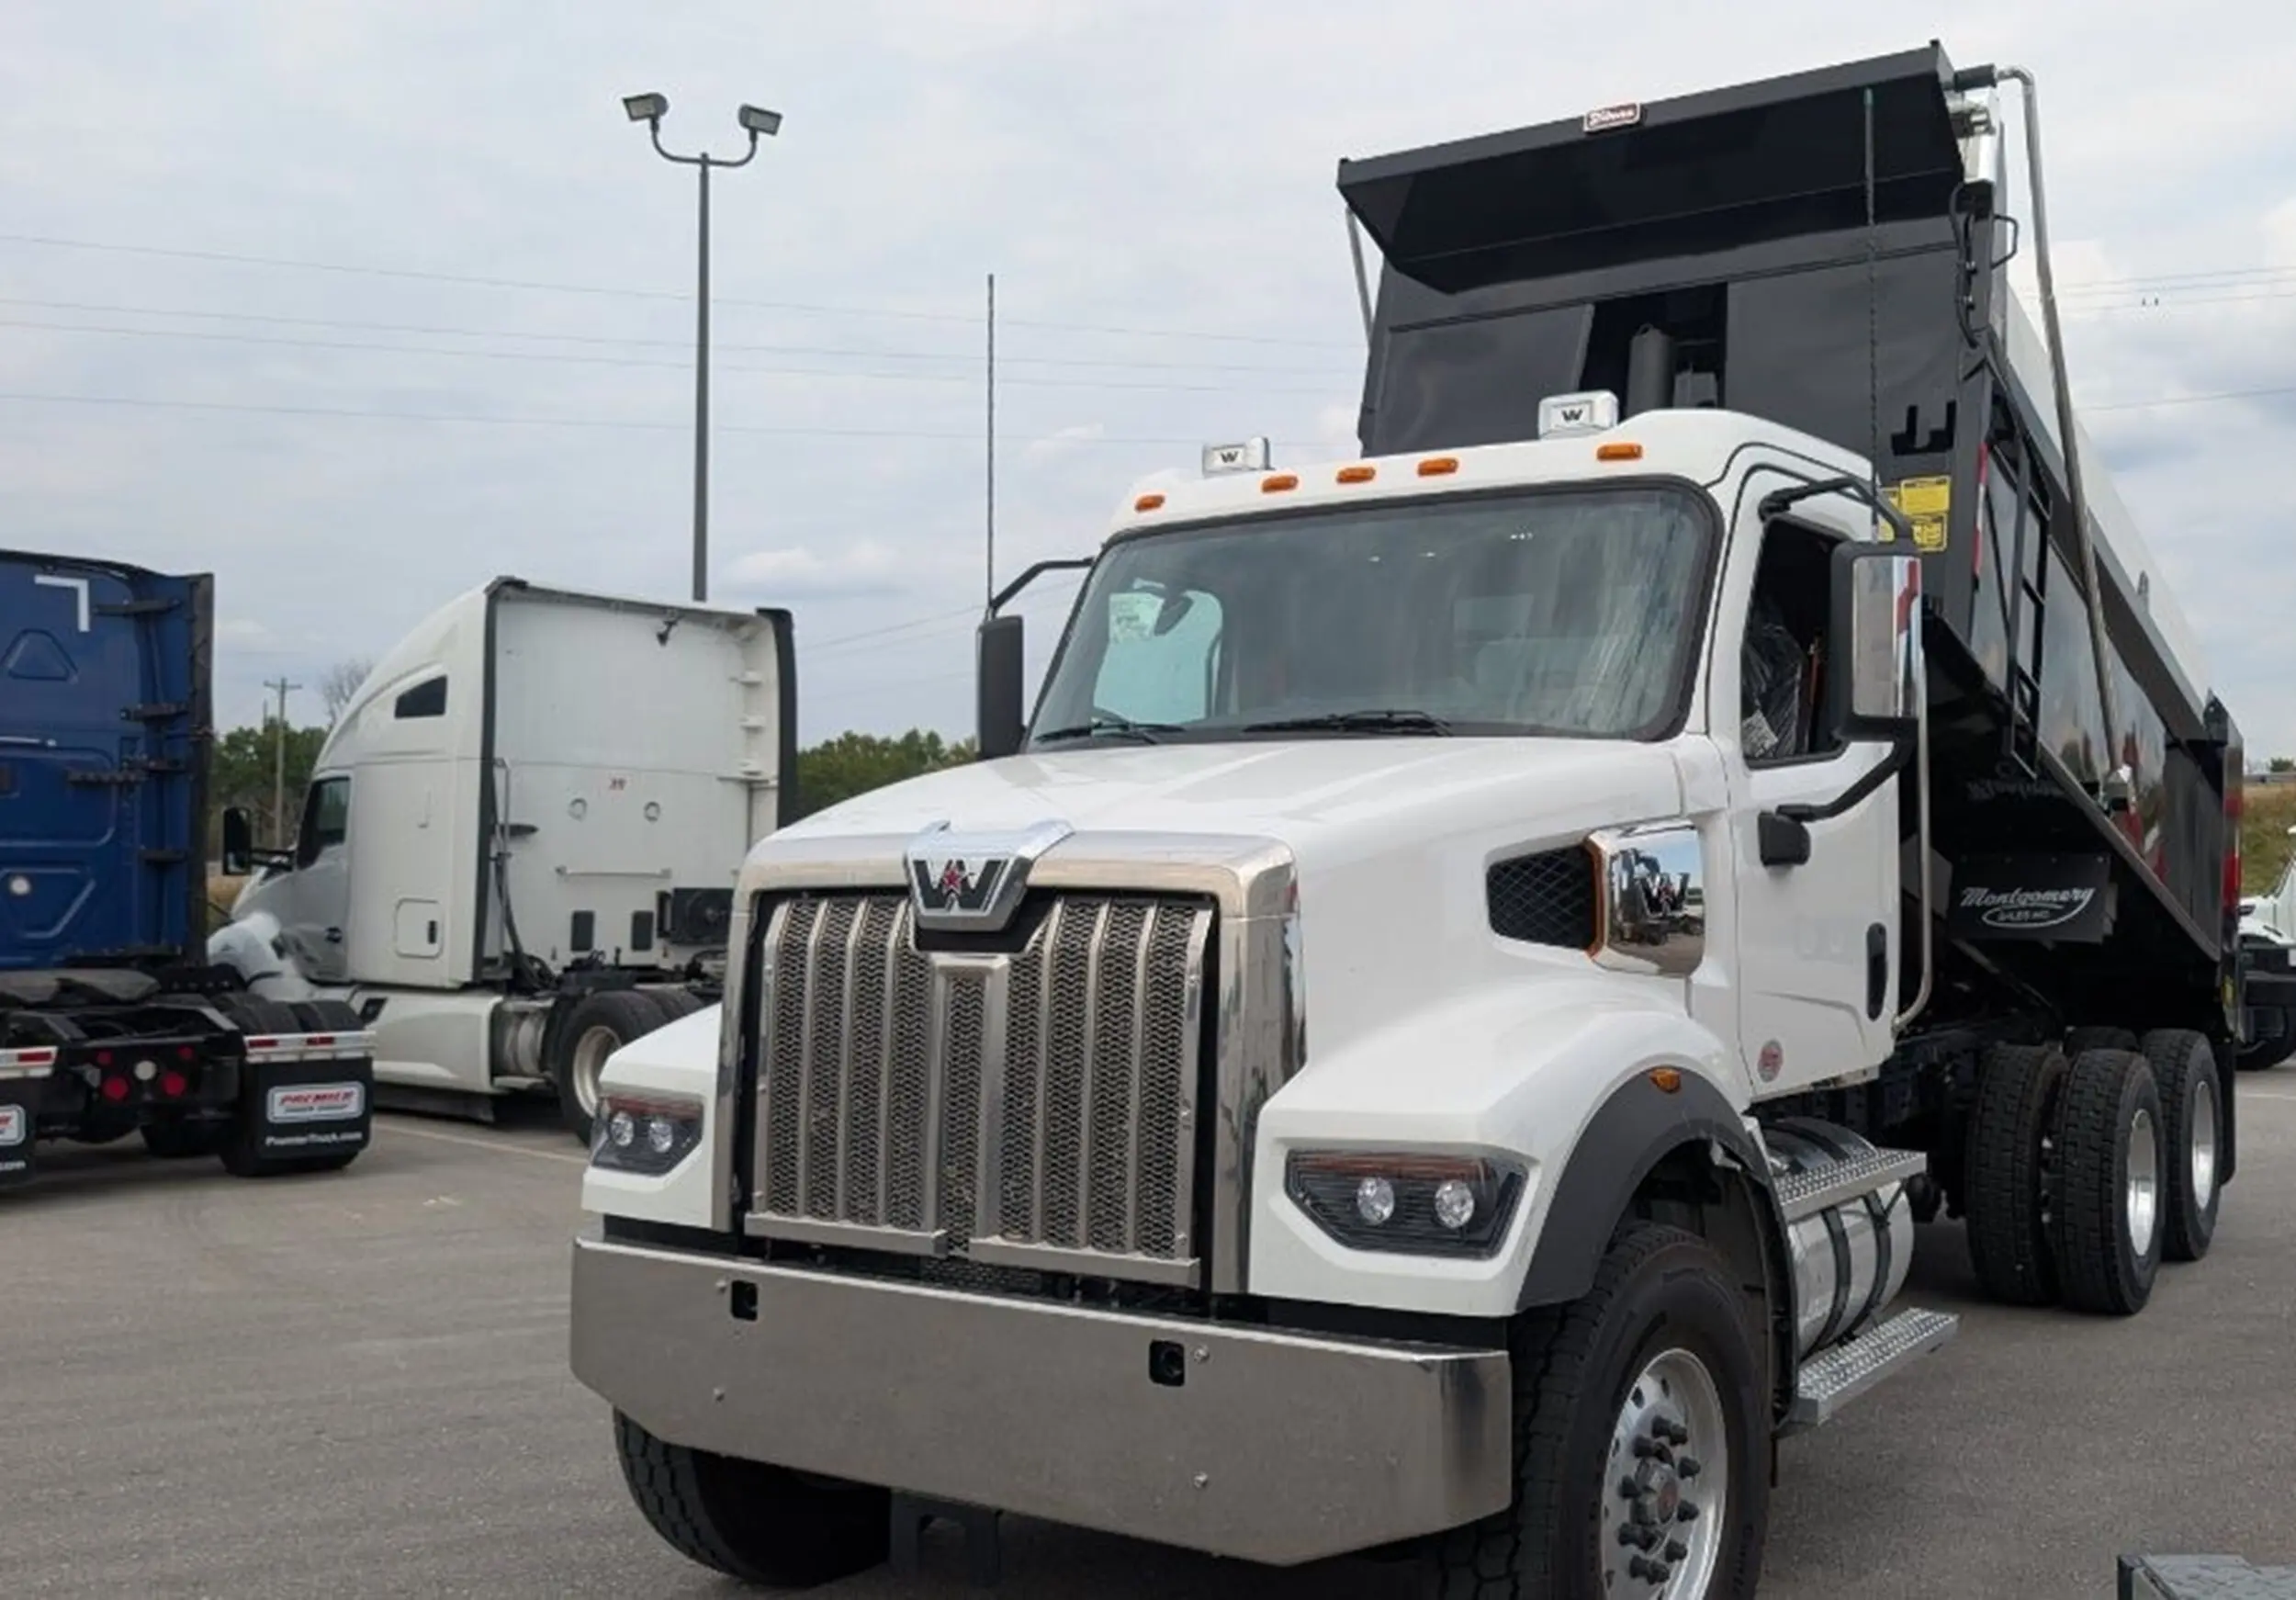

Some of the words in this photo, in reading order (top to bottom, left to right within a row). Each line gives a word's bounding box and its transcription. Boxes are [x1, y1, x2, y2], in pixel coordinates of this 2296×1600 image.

[1562, 409, 1583, 421] W
[1220, 450, 1239, 463] W
[1960, 886, 2096, 907] Montgomery
